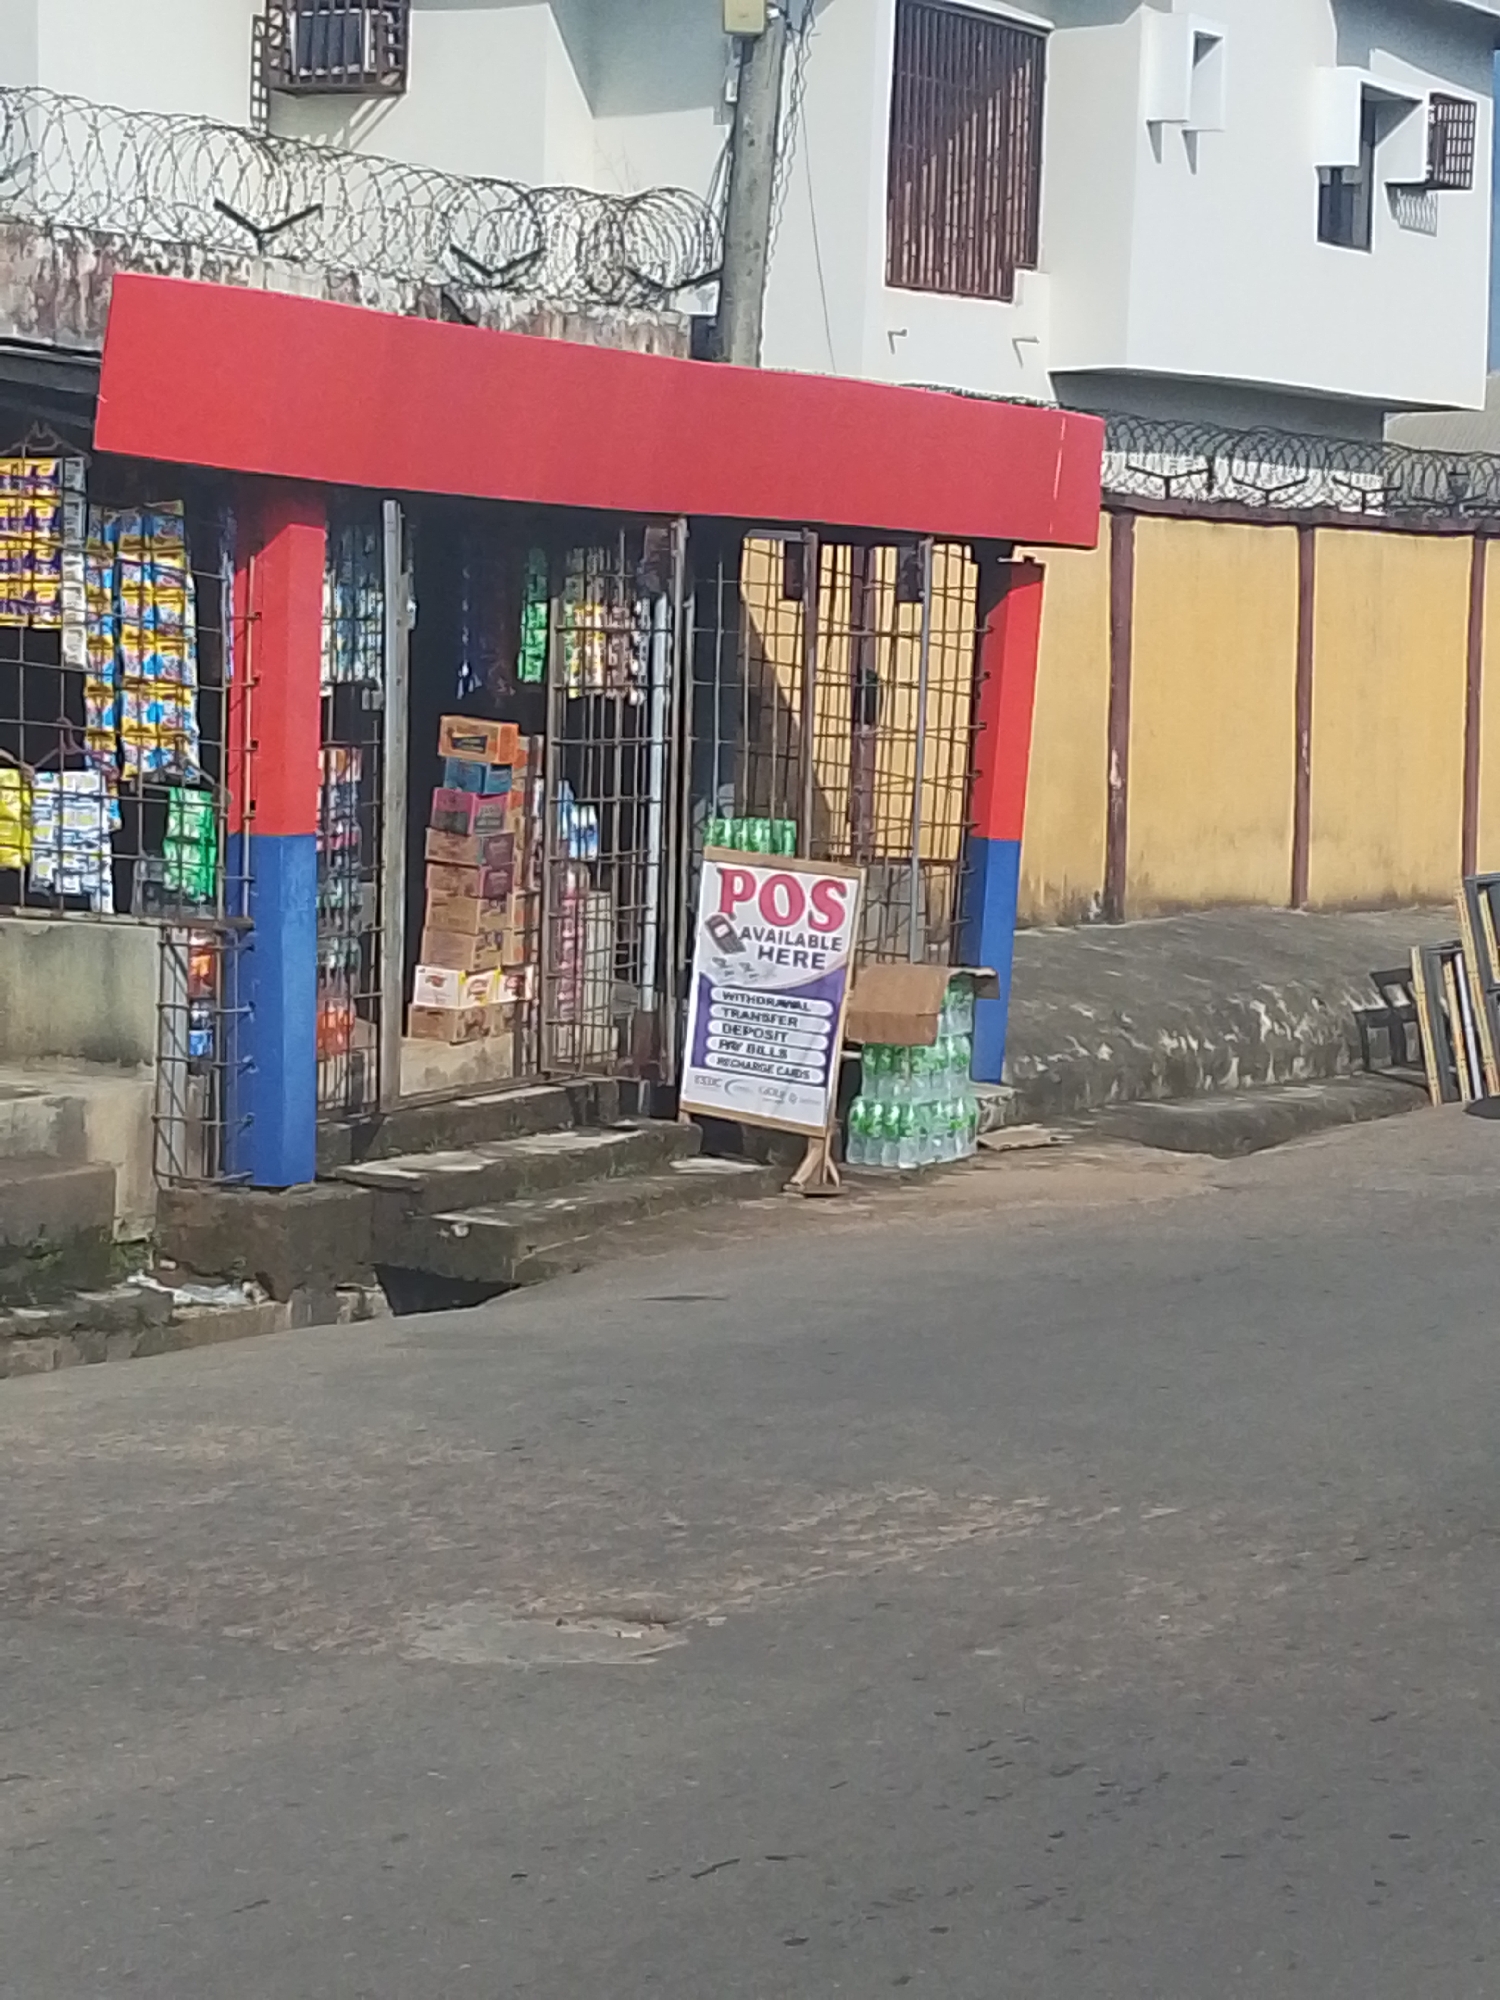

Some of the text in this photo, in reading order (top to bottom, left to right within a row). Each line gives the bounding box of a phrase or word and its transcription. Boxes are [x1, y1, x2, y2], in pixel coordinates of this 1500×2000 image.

[717, 867, 848, 933] POS
[739, 926, 843, 952] AVAILABLE
[758, 945, 826, 970] HERE
[722, 991, 811, 1012] WITHDRAWAL
[721, 1008, 798, 1027] TRANSFER
[722, 1023, 789, 1042] DEPOSIT
